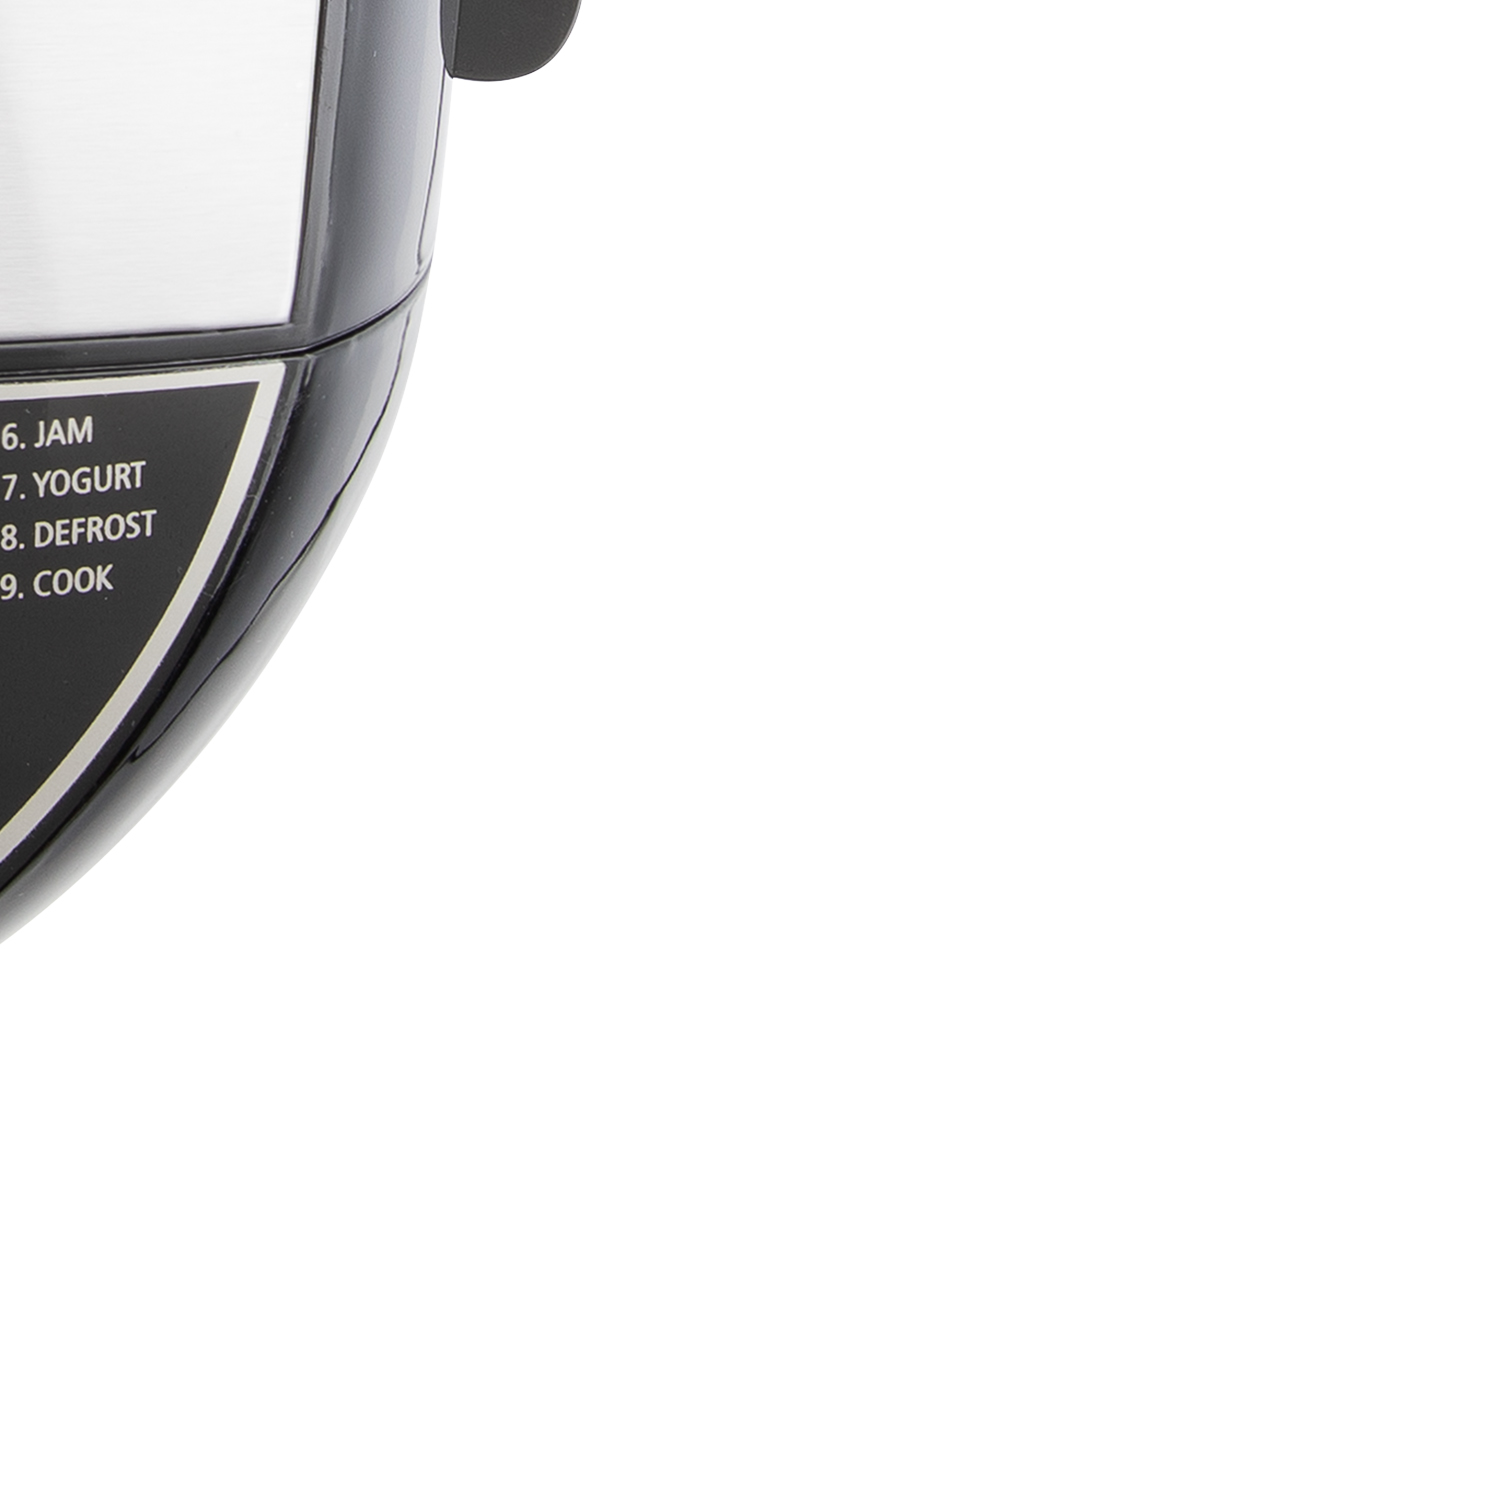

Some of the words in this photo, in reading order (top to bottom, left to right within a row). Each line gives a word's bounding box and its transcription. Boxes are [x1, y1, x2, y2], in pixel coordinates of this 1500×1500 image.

[34, 415, 93, 448] JAM
[32, 460, 147, 498] YOGURT
[34, 509, 158, 548] DEFROST
[33, 563, 114, 597] COOK
